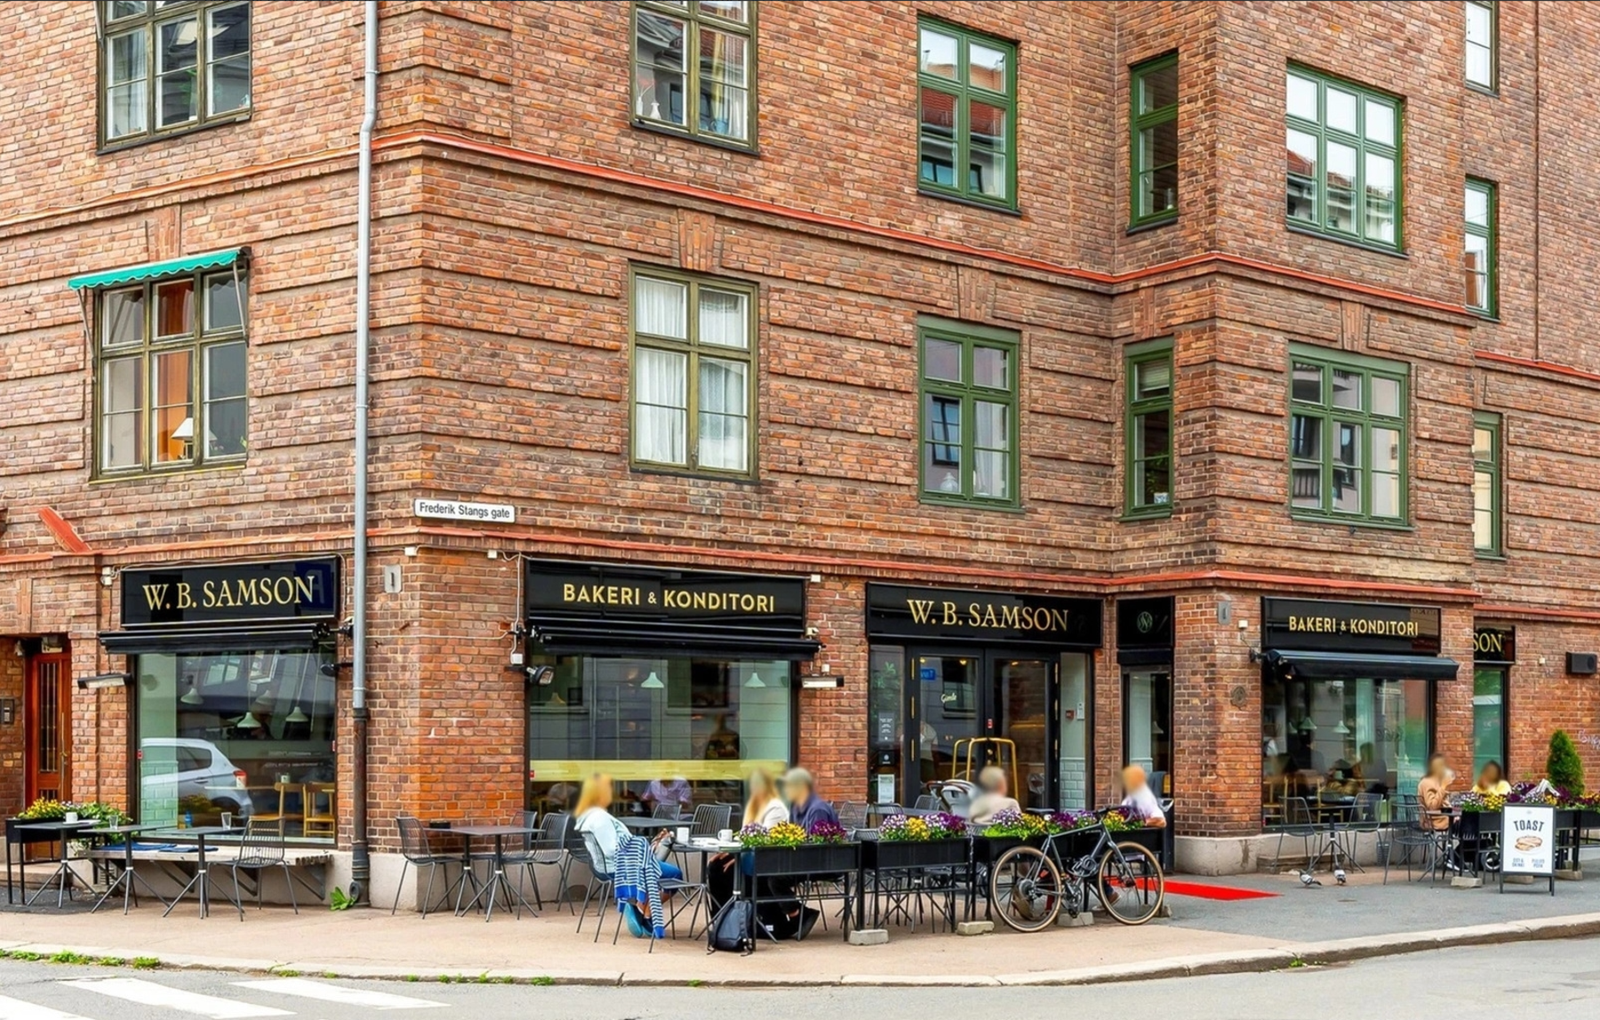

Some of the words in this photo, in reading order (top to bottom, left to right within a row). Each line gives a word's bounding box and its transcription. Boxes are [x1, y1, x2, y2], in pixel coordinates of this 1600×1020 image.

[419, 502, 456, 515] Frederik
[458, 504, 489, 519] Stangs
[490, 508, 510, 520] gate
[142, 583, 171, 611] W.
[176, 582, 197, 609] B.
[203, 575, 315, 608] SAMSON
[563, 583, 640, 606] BAKERI
[647, 591, 657, 605] &
[663, 589, 775, 613] KONDITORI
[906, 599, 937, 625] W.
[942, 601, 964, 626] B.
[968, 602, 1068, 631] SAMSON
[1289, 615, 1337, 633] BAKERI
[1340, 620, 1347, 632] &
[1350, 618, 1419, 636] KONDITORI
[1513, 819, 1545, 832] TOAST
